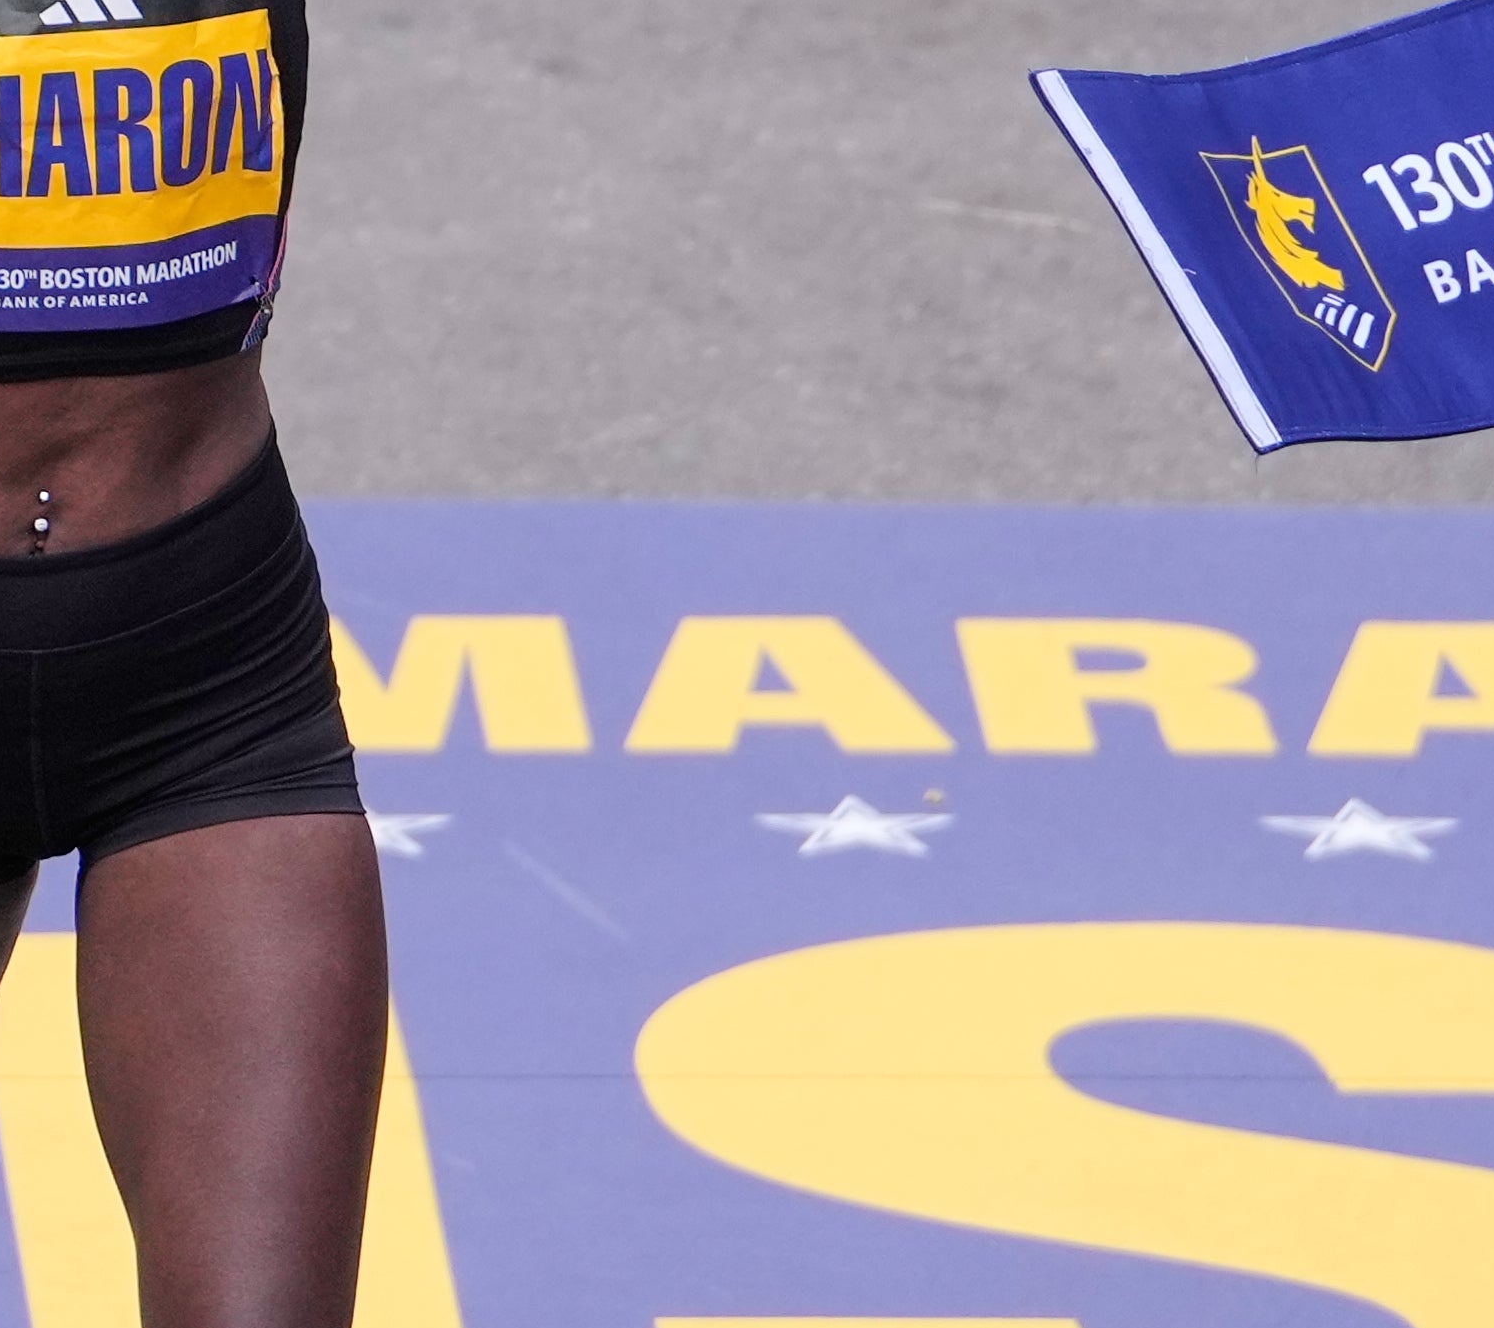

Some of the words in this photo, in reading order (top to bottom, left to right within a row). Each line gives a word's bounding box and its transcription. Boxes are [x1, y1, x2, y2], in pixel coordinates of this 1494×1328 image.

[39, 265, 131, 290] BOSTON
[136, 241, 238, 286] MARATHON
[43, 295, 66, 309] OF
[69, 291, 149, 309] AMERICA
